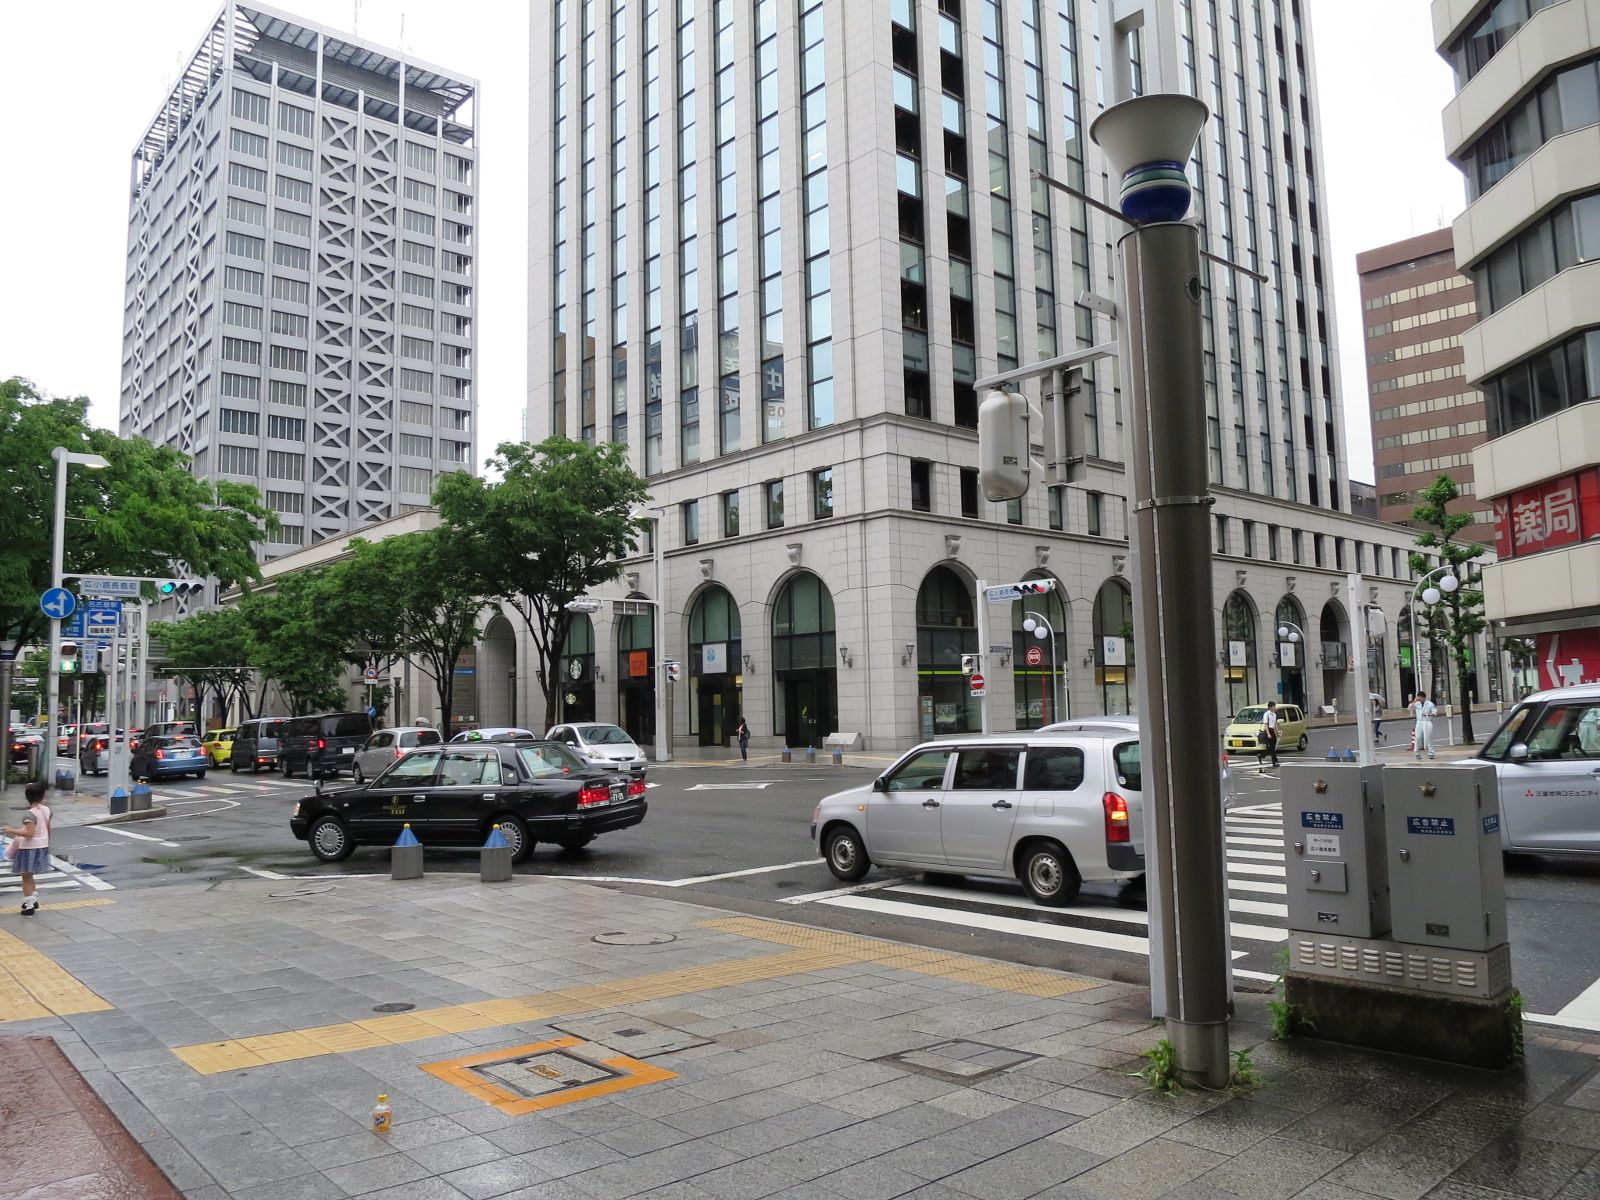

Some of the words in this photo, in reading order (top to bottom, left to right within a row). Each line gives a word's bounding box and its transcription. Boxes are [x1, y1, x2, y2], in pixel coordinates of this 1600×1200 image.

[1512, 488, 1577, 546] 薬局
[1306, 813, 1339, 822] 広告禁止
[1412, 818, 1449, 827] 広告禁止
